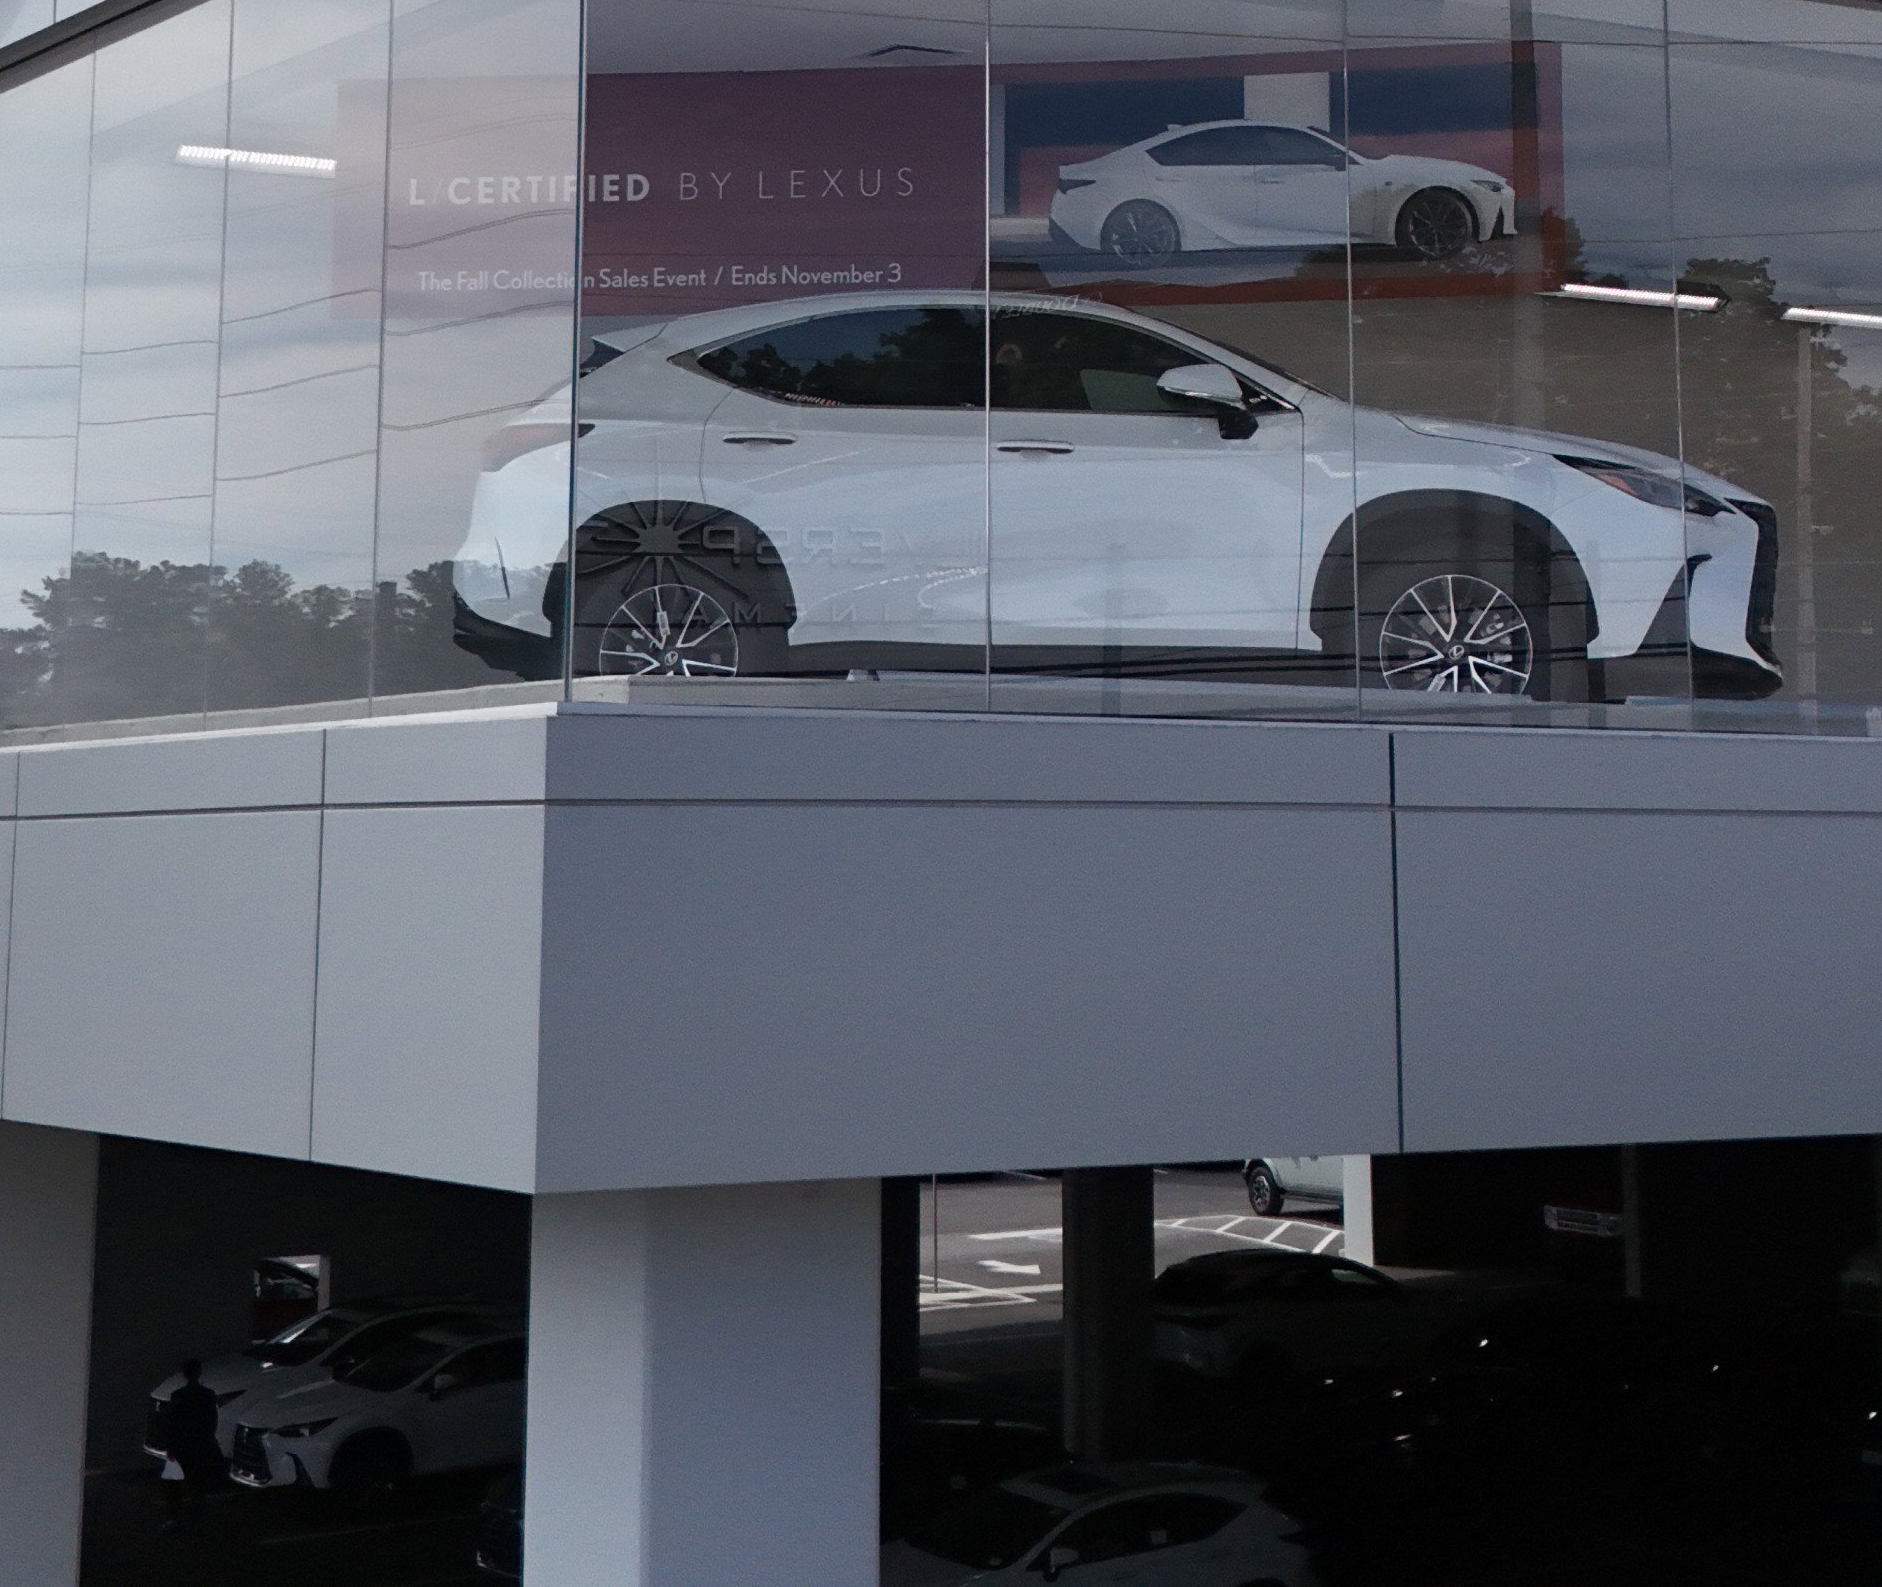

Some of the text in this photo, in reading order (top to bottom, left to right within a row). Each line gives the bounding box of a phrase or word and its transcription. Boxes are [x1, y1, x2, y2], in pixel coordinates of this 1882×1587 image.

[680, 173, 730, 200] BY
[759, 168, 913, 198] LEXUS
[418, 270, 453, 291] The
[457, 268, 489, 290] Fall
[599, 267, 649, 288] Sales
[652, 266, 707, 287] Event
[731, 265, 778, 286] Ends
[781, 264, 885, 285] November
[887, 263, 902, 285] 3
